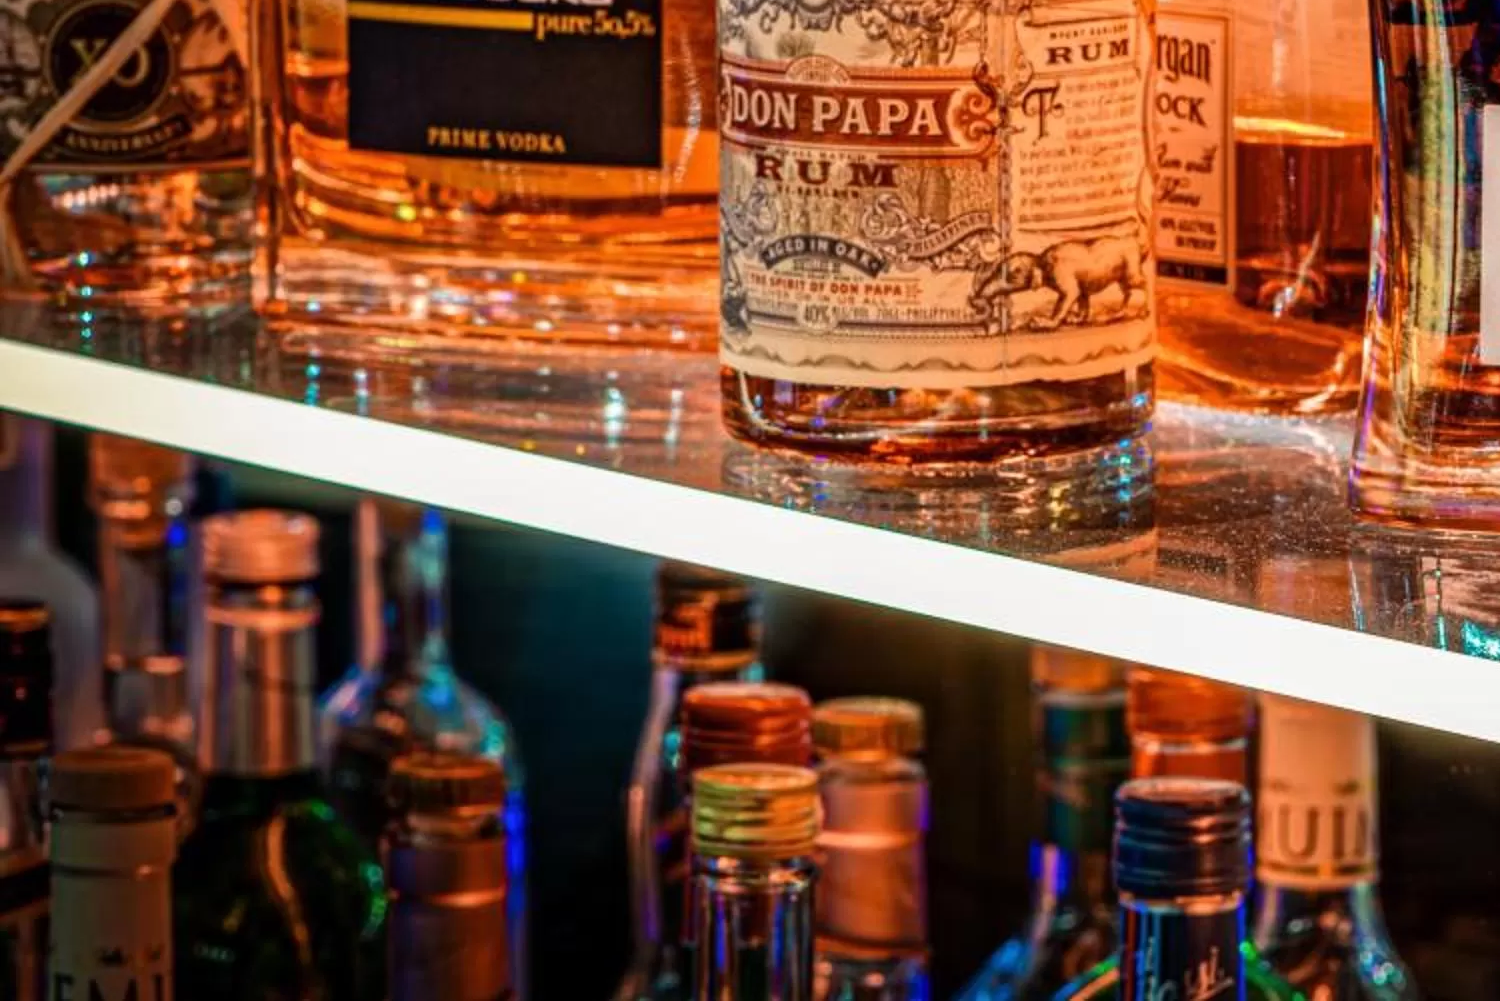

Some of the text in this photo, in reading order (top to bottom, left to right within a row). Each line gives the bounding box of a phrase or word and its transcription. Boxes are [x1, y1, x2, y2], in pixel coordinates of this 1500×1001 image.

[536, 12, 593, 41] pure
[1046, 38, 1130, 65] RUM
[1156, 34, 1211, 85] rgan
[732, 84, 942, 136] DON PAPA
[1156, 93, 1206, 127] OCK
[428, 127, 566, 153] PRIME VODKA
[755, 154, 899, 187] RUM
[767, 239, 805, 259] AGED
[810, 239, 829, 251] IN
[835, 242, 871, 266] OAK
[769, 275, 807, 291] SPIRIT
[810, 281, 825, 293] OF
[830, 282, 859, 294] DON
[864, 283, 902, 297] PAPA
